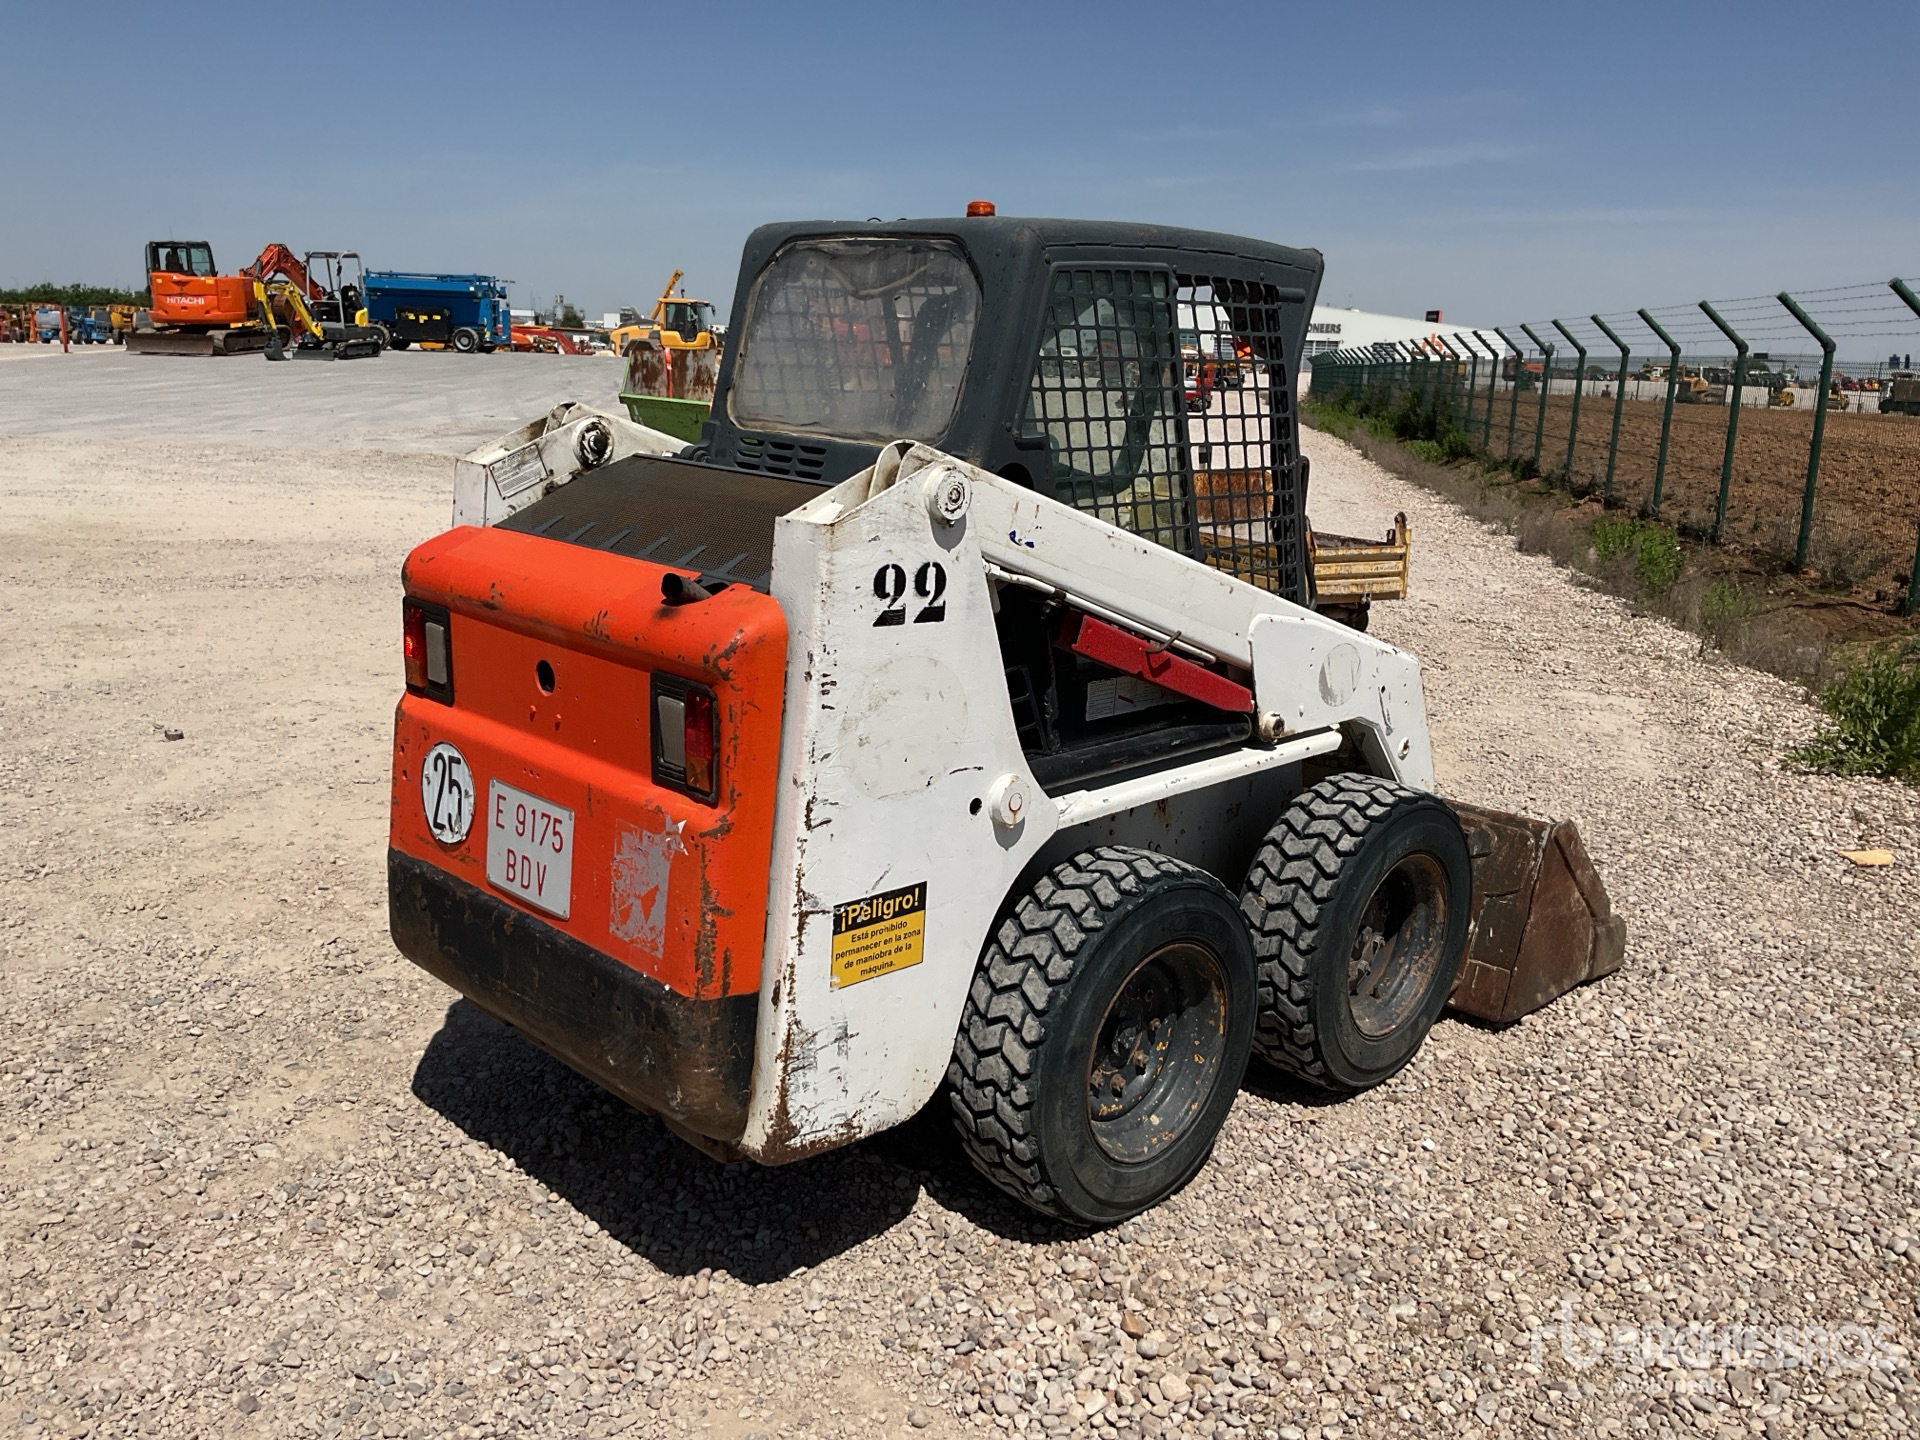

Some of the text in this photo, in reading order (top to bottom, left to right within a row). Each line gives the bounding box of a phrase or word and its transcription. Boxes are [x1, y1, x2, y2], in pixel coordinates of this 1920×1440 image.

[167, 297, 204, 305] HITACHI
[1307, 323, 1342, 334] ONEERS
[872, 561, 947, 627] 22
[433, 752, 462, 835] 25
[496, 793, 563, 853] E 9175
[506, 848, 547, 896] BDV
[841, 887, 919, 932] ¡Peligro!
[835, 929, 921, 961] permanecer en la zona
[851, 920, 908, 943] Está prohibido
[844, 943, 912, 969] de maniobra de la
[860, 960, 896, 976] máquina.
